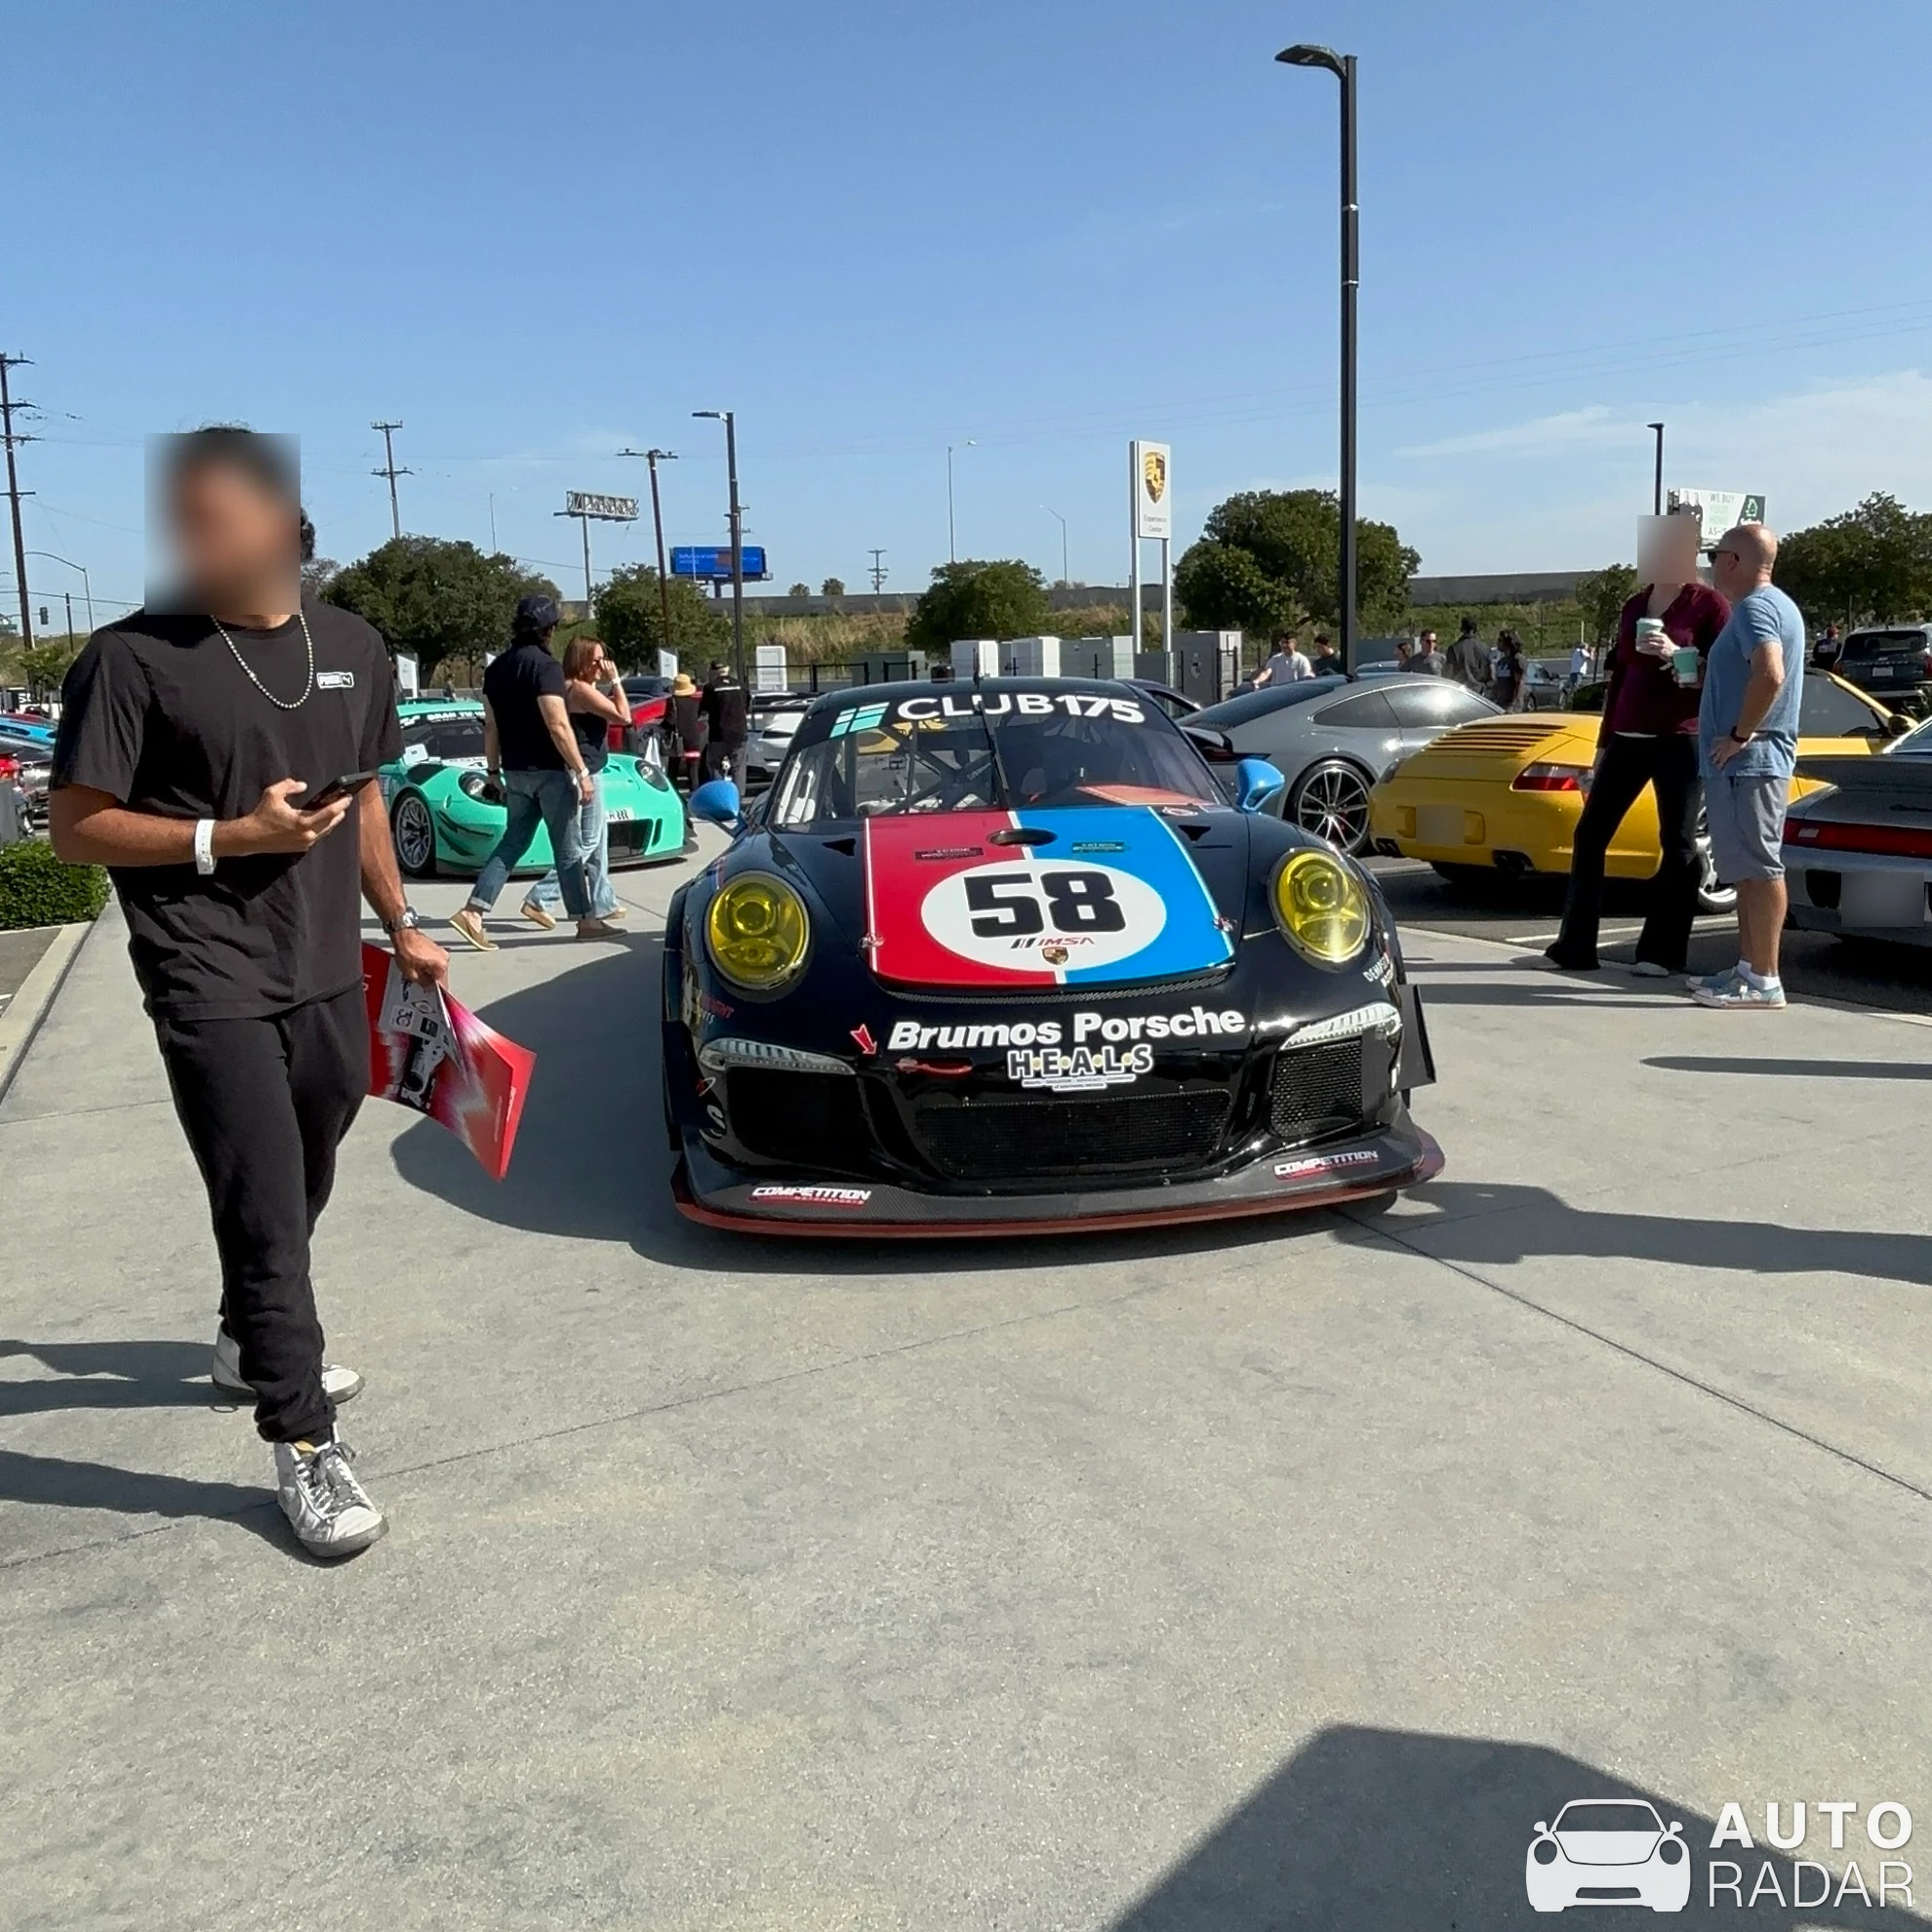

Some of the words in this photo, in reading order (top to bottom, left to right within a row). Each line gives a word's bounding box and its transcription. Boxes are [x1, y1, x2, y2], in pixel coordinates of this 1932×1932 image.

[964, 872, 1127, 938] 58
[1037, 937, 1096, 946] IMSA
[888, 1021, 1063, 1051] Brumos
[1074, 1006, 1245, 1043] Porsche
[1274, 1151, 1379, 1175] COMPETITION
[752, 1187, 871, 1201] COMPETITION
